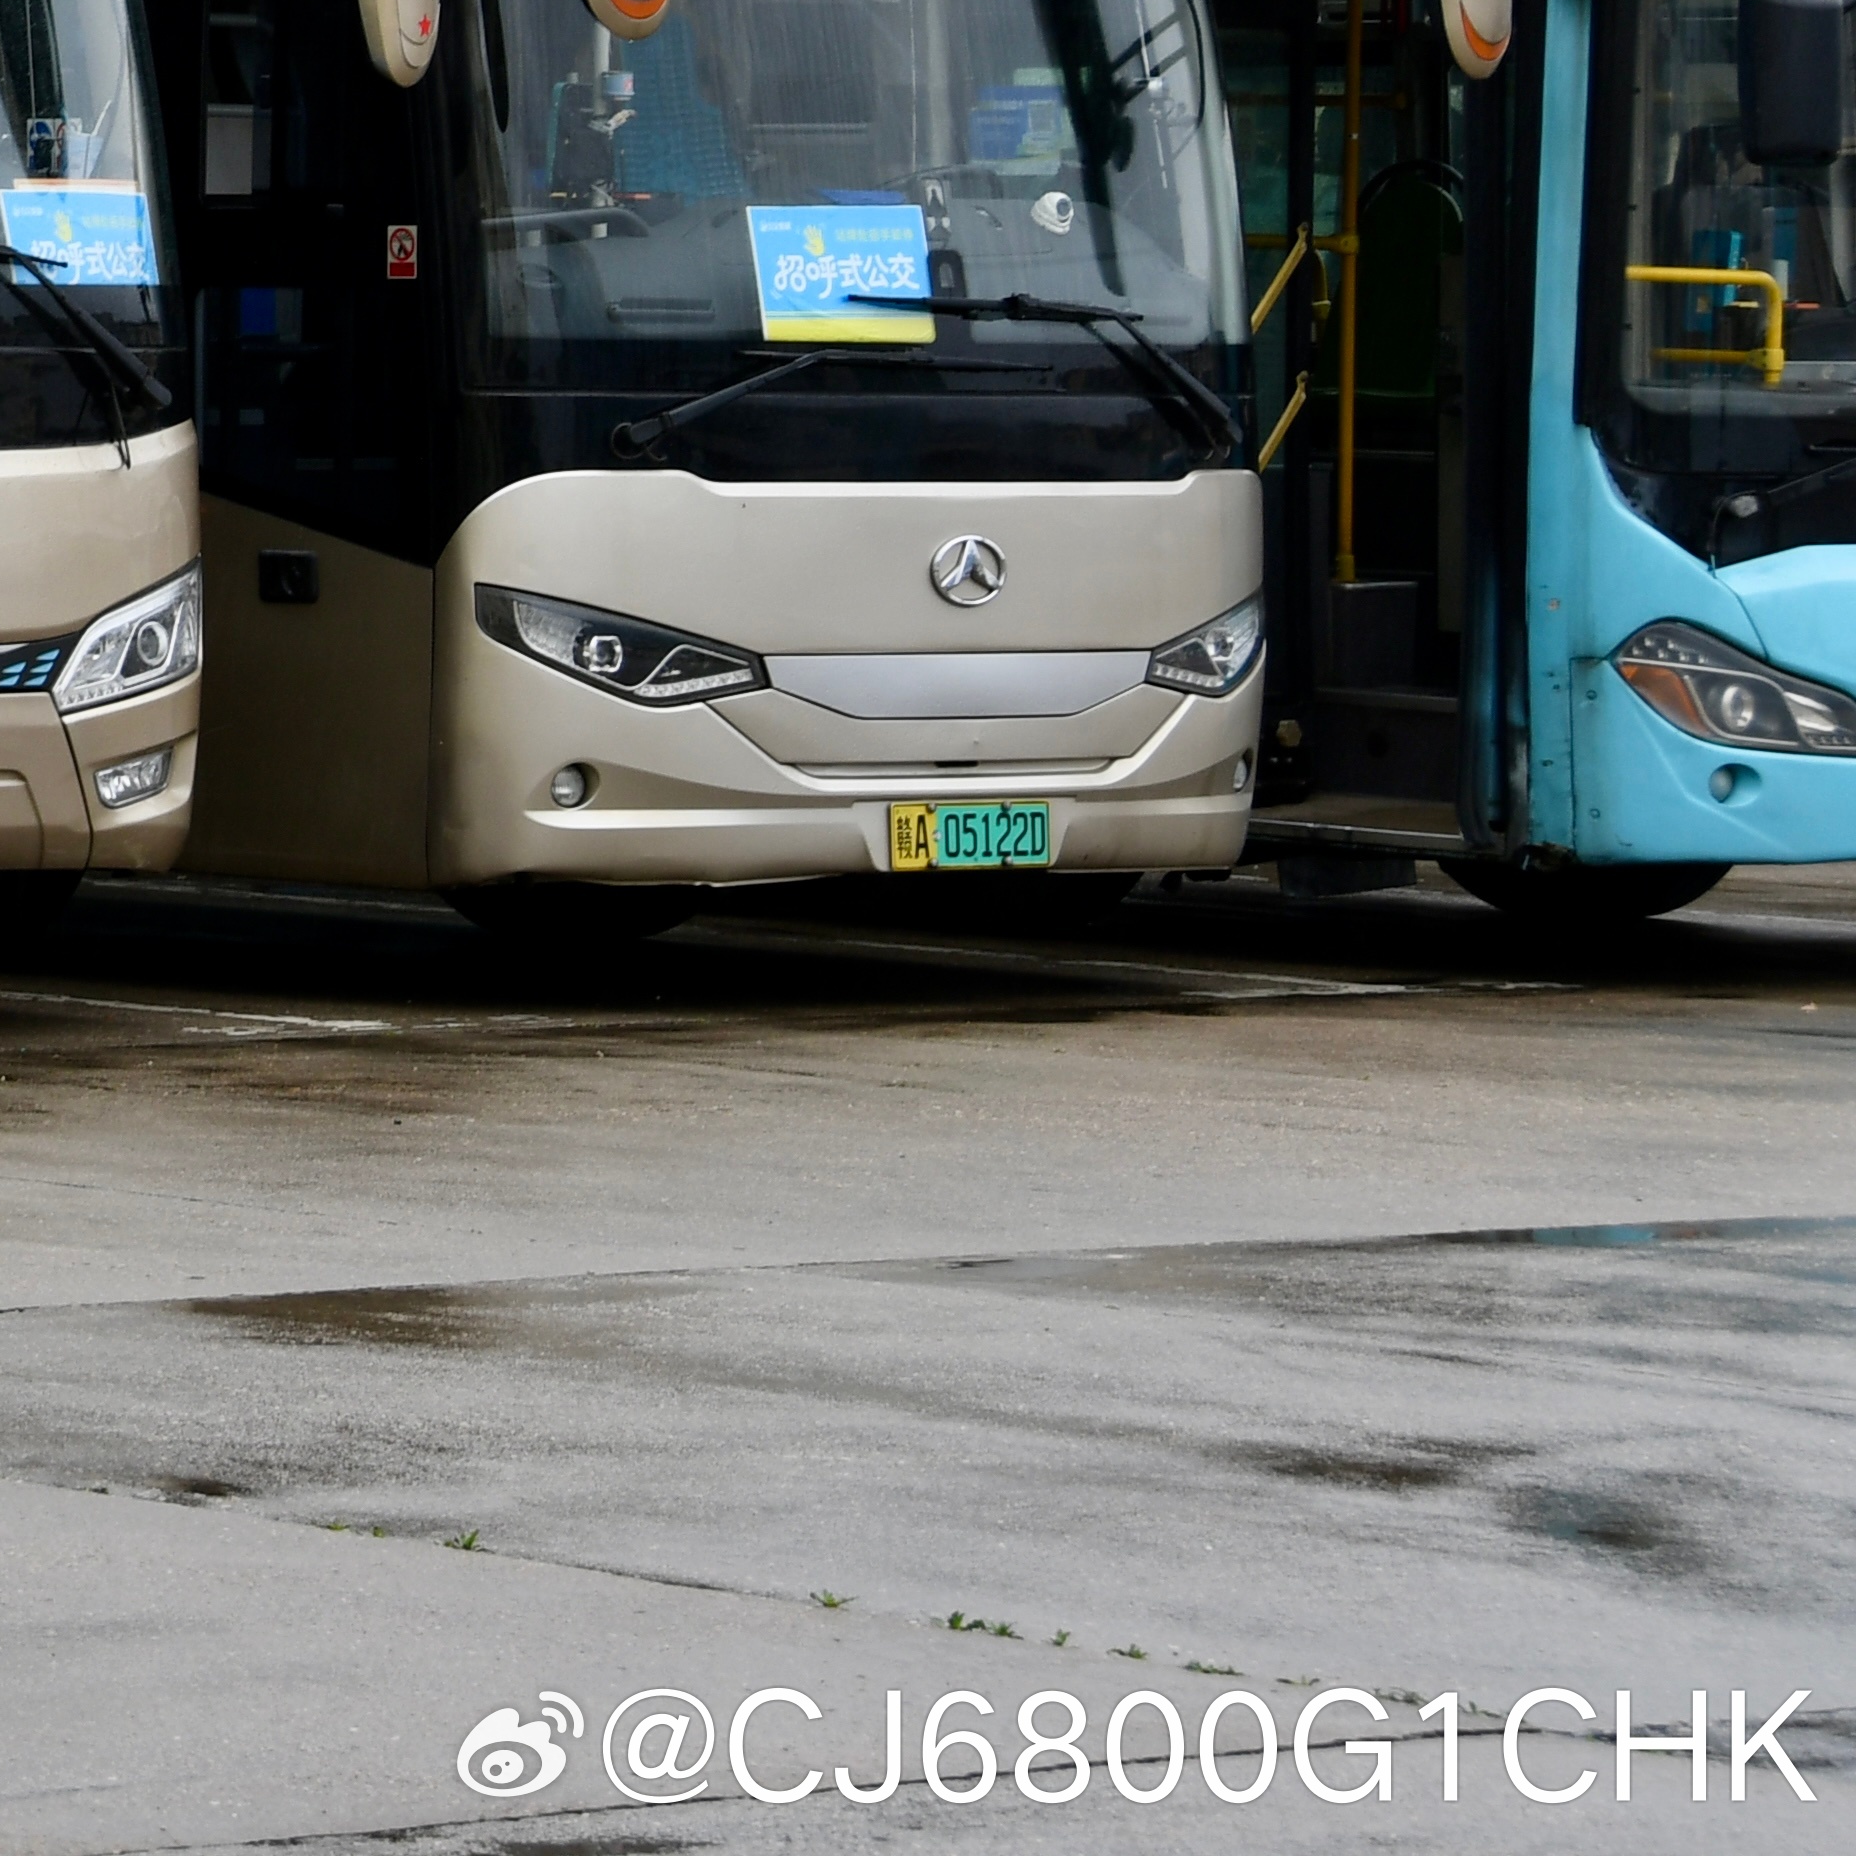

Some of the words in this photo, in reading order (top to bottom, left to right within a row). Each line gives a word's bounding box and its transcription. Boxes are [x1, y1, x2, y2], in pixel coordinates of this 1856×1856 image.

[31, 240, 150, 285] 招呼式公交
[774, 252, 920, 299] 招呼式公交
